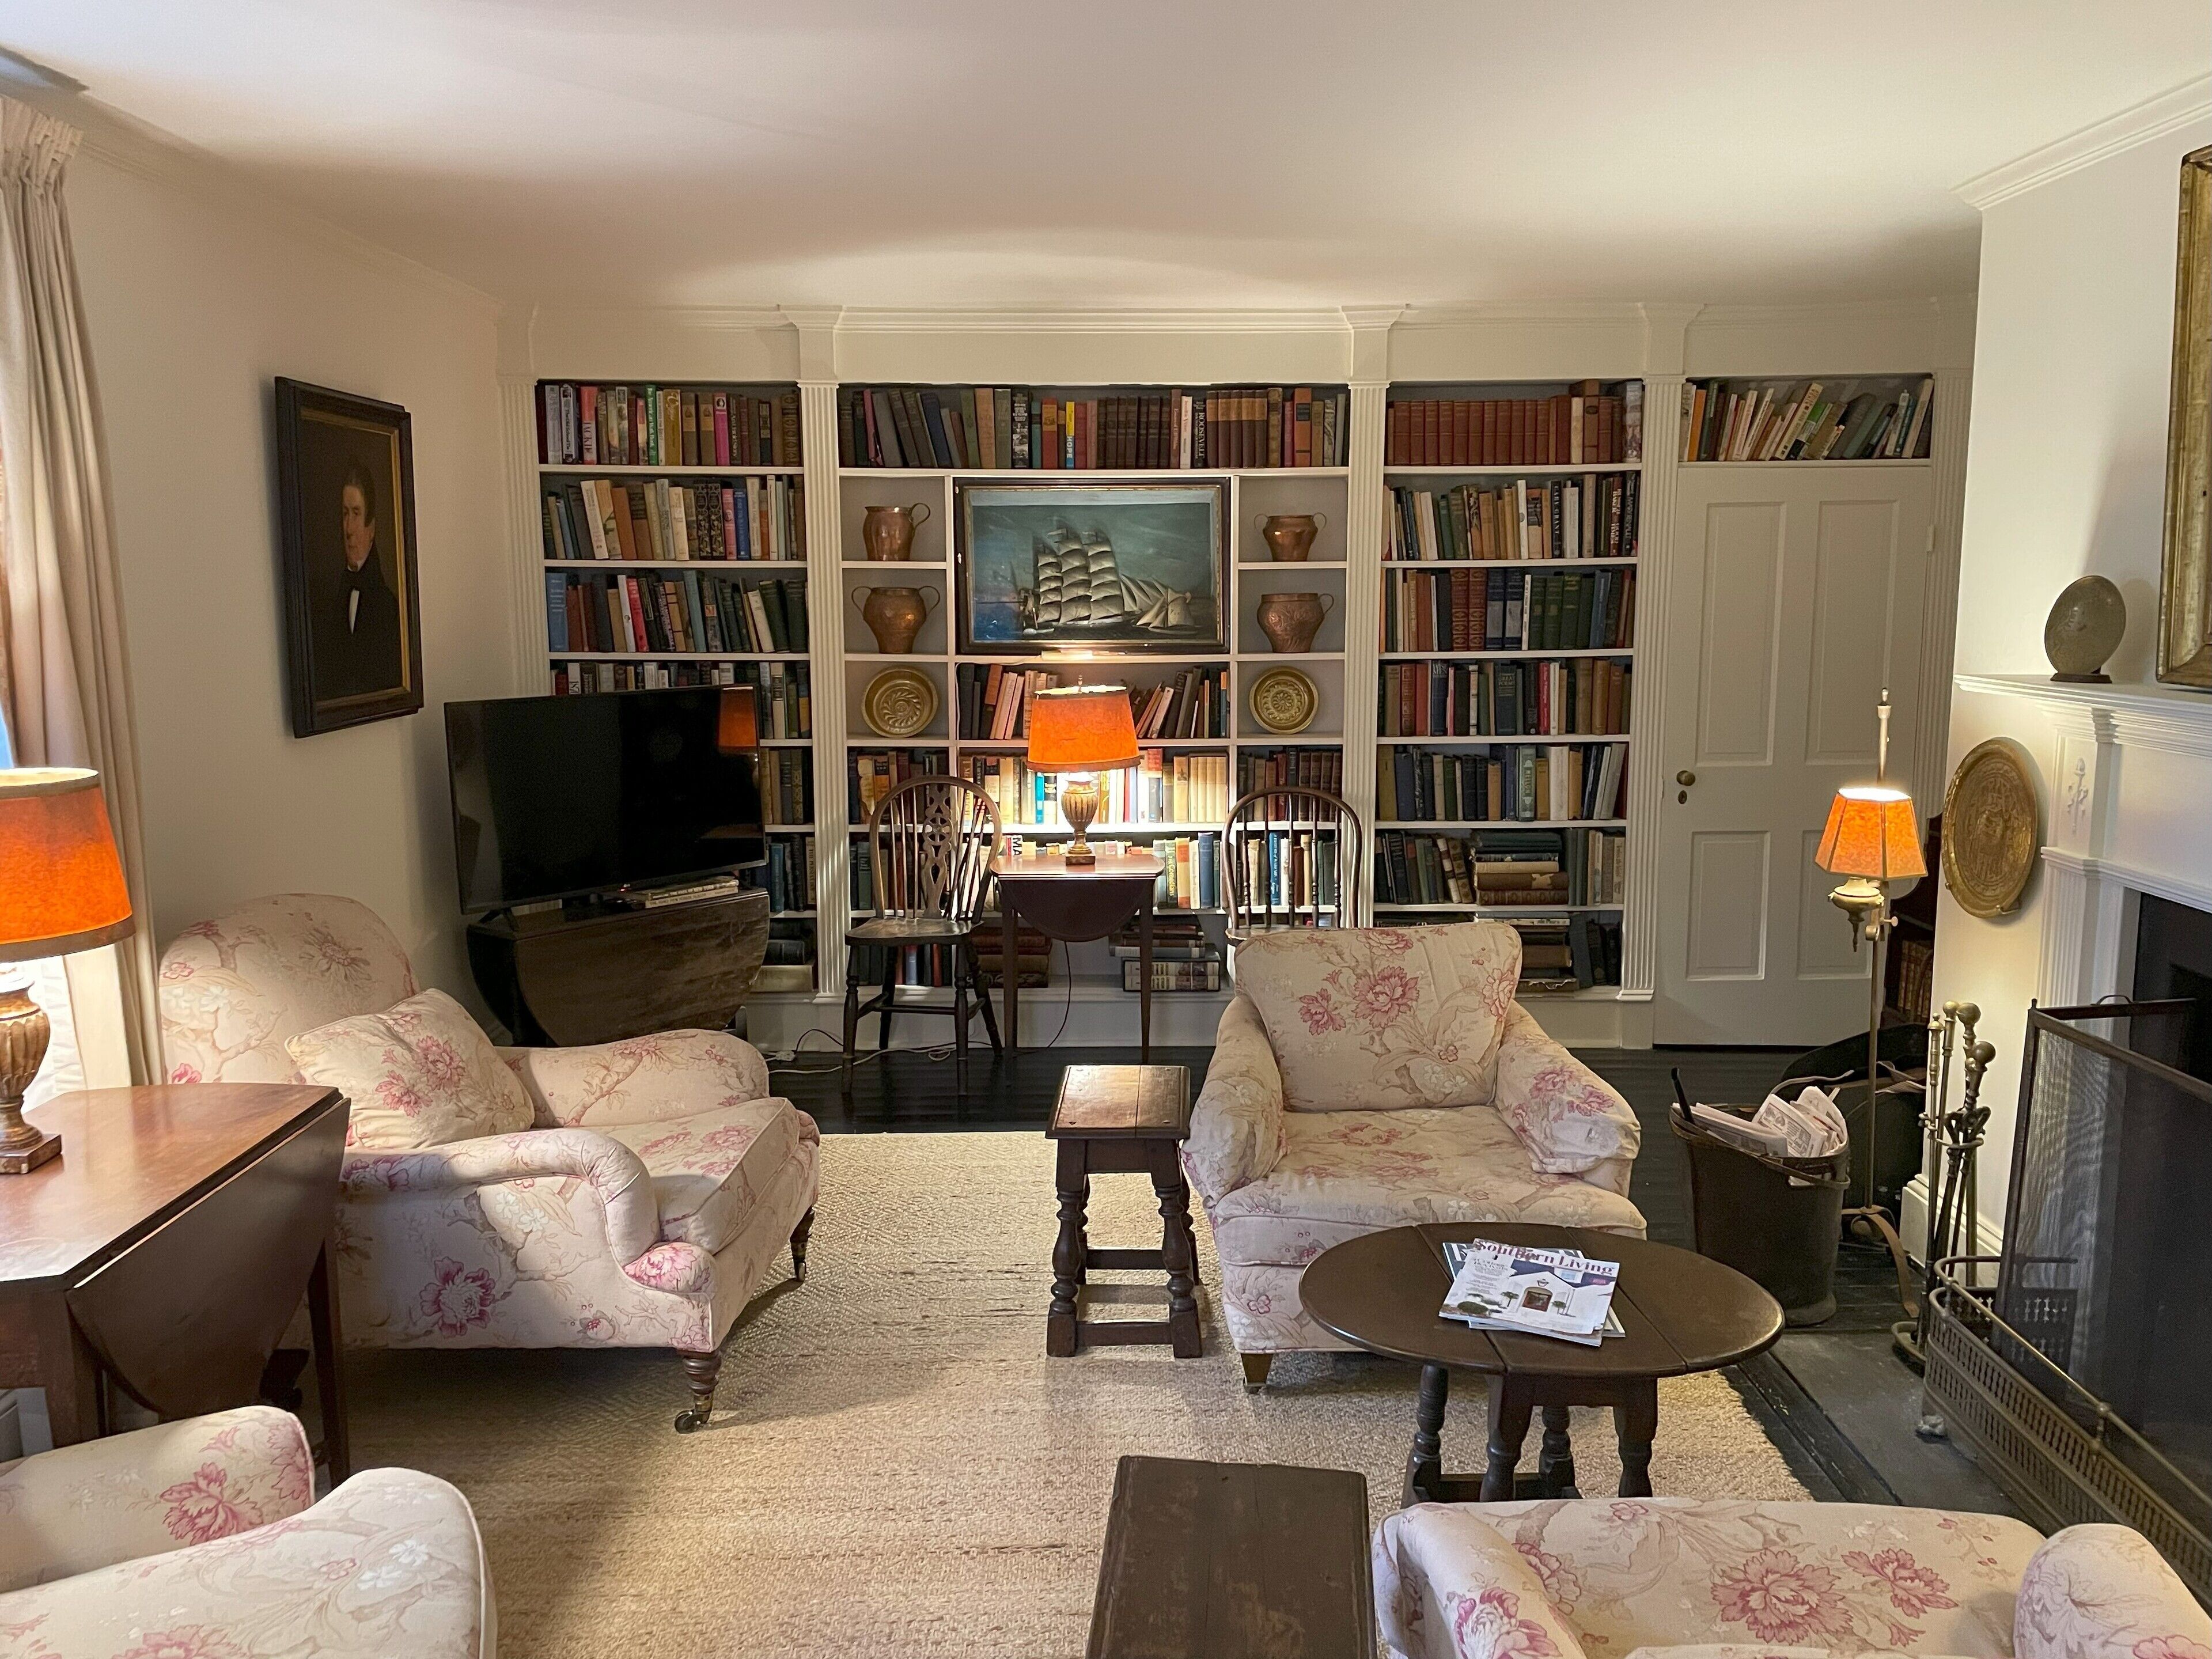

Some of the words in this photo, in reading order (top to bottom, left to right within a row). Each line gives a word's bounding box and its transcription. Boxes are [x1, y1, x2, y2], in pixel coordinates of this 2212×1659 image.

[584, 422, 593, 454] JACKIE
[1167, 865, 1175, 896] Comedians
[1475, 1240, 1555, 1265] Southern
[1559, 1256, 1615, 1275] Living
